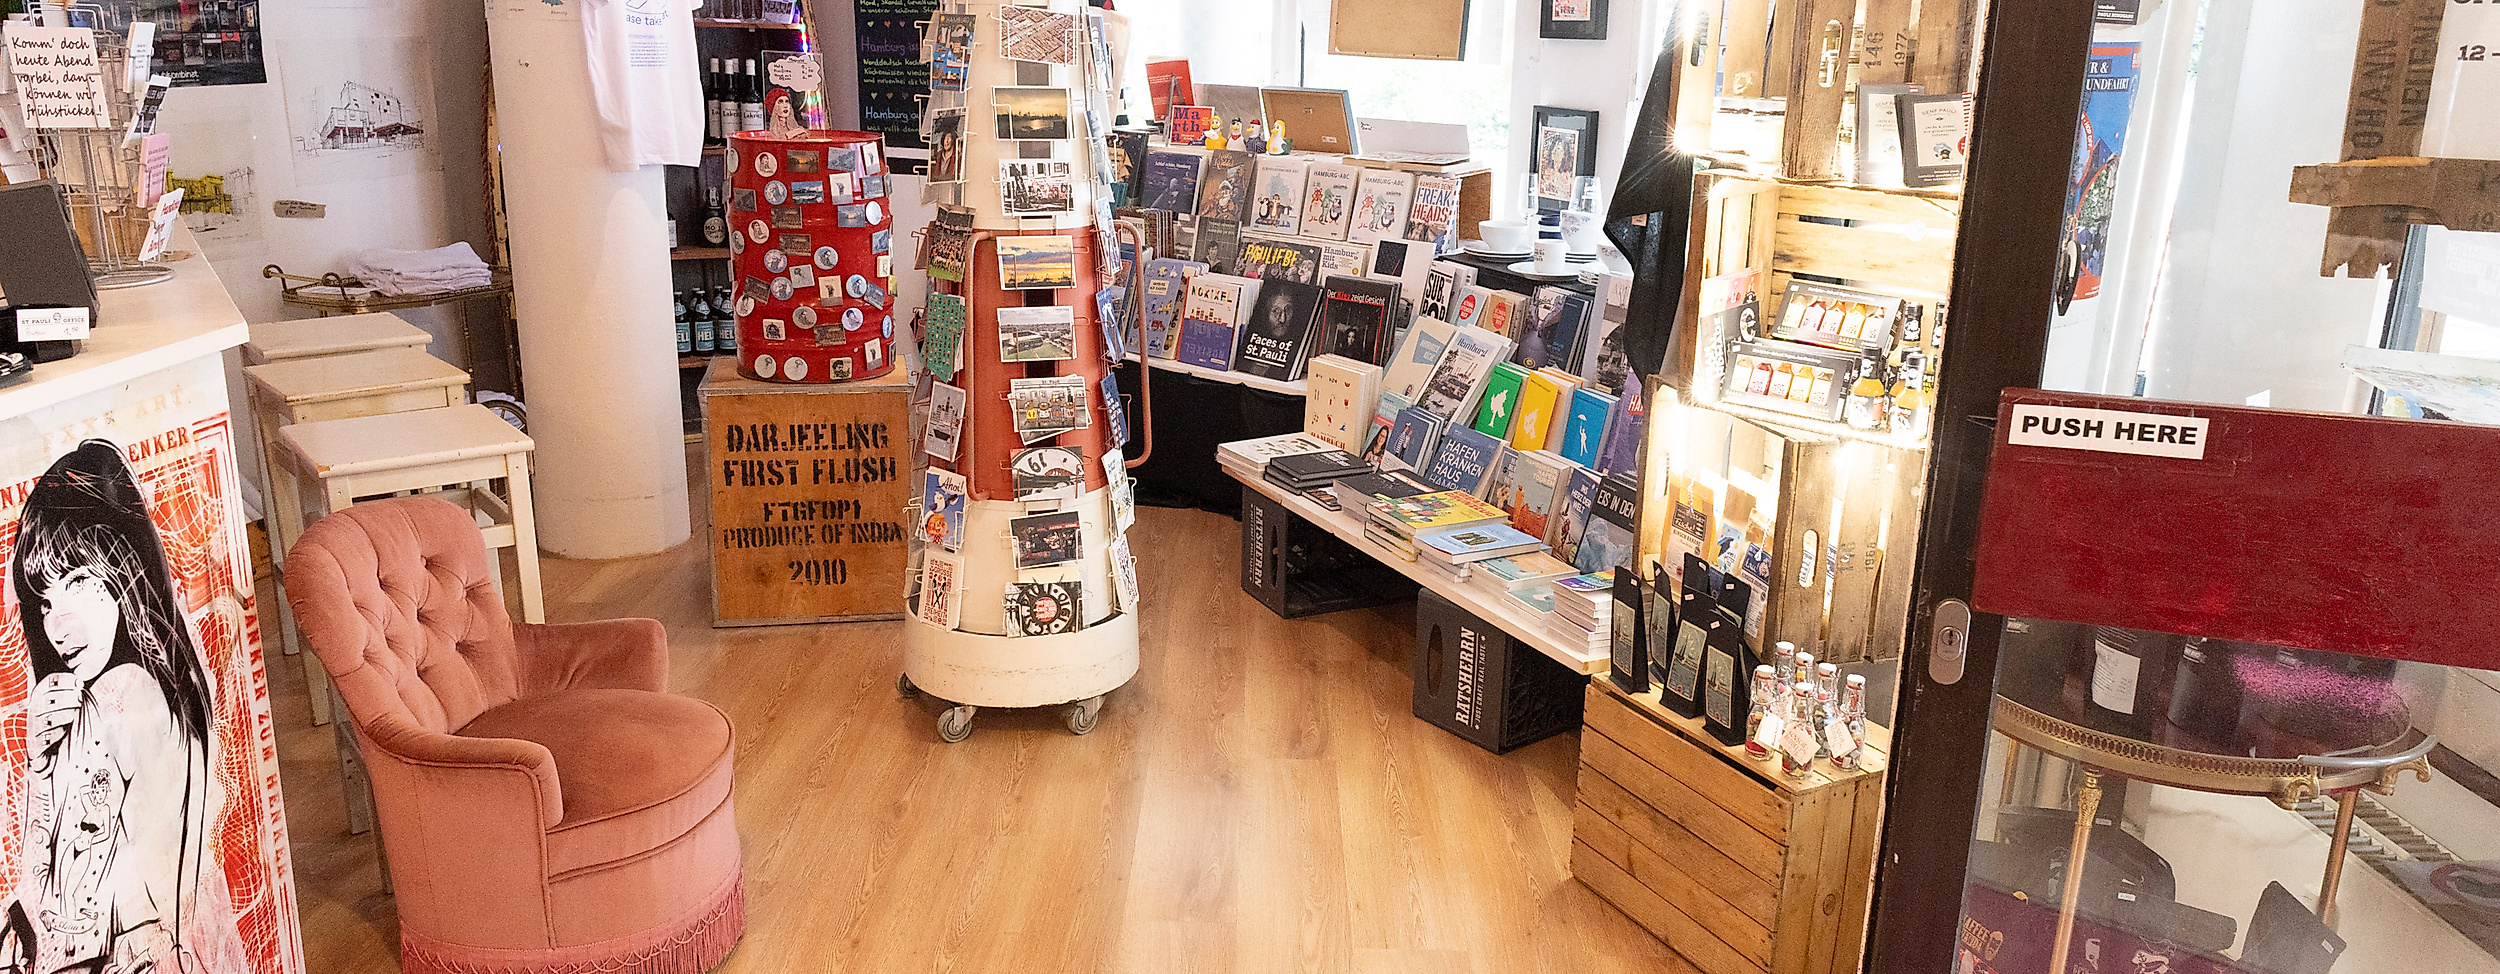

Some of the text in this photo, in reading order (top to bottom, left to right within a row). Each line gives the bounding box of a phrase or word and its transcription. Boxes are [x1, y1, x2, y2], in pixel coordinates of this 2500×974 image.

[60, 35, 90, 49] doch
[1864, 31, 1885, 69] 146
[1894, 32, 1907, 67] 1977
[2458, 45, 2487, 61] 12
[15, 52, 94, 67] heute Abend
[2100, 61, 2109, 74] &
[17, 70, 95, 84] vorbei, dann
[2086, 77, 2130, 91] UNDFAHRT
[25, 86, 97, 100] können wir
[2350, 39, 2398, 150] OHANN
[865, 106, 908, 123] Hamburg
[1415, 187, 1452, 207] FREAK
[1412, 203, 1449, 223] HEADS
[1243, 243, 1301, 268] PAULIEBE
[1321, 260, 1339, 270] Kids
[1322, 253, 1336, 261] mit
[1326, 288, 1386, 305] Der Kiez zeigt Gesicht
[697, 330, 714, 342] HEL
[719, 329, 735, 340] HEL
[1249, 333, 1293, 352] Faces of
[1457, 338, 1489, 358] Hamburg
[136, 386, 184, 418] ART
[727, 422, 888, 453] DARJEELING
[2022, 415, 2198, 445] PUSH HERE
[126, 426, 189, 463] ENKER
[1445, 438, 1480, 462] HAFEN
[723, 456, 896, 487] FIRST FLUSH
[1432, 461, 1463, 483] HAUS
[1439, 450, 1485, 478] KRANKEN
[940, 477, 964, 494] Ahoi!
[1596, 489, 1611, 508] EIS
[1610, 494, 1621, 512] IN
[723, 521, 903, 550] PRODUCE OF INDIA
[1254, 506, 1264, 589] RATSHERRN
[788, 558, 848, 586] 2010
[1455, 626, 1476, 726] RATSHERRN
[257, 709, 276, 764] ZUM
[266, 772, 288, 880] HENKER
